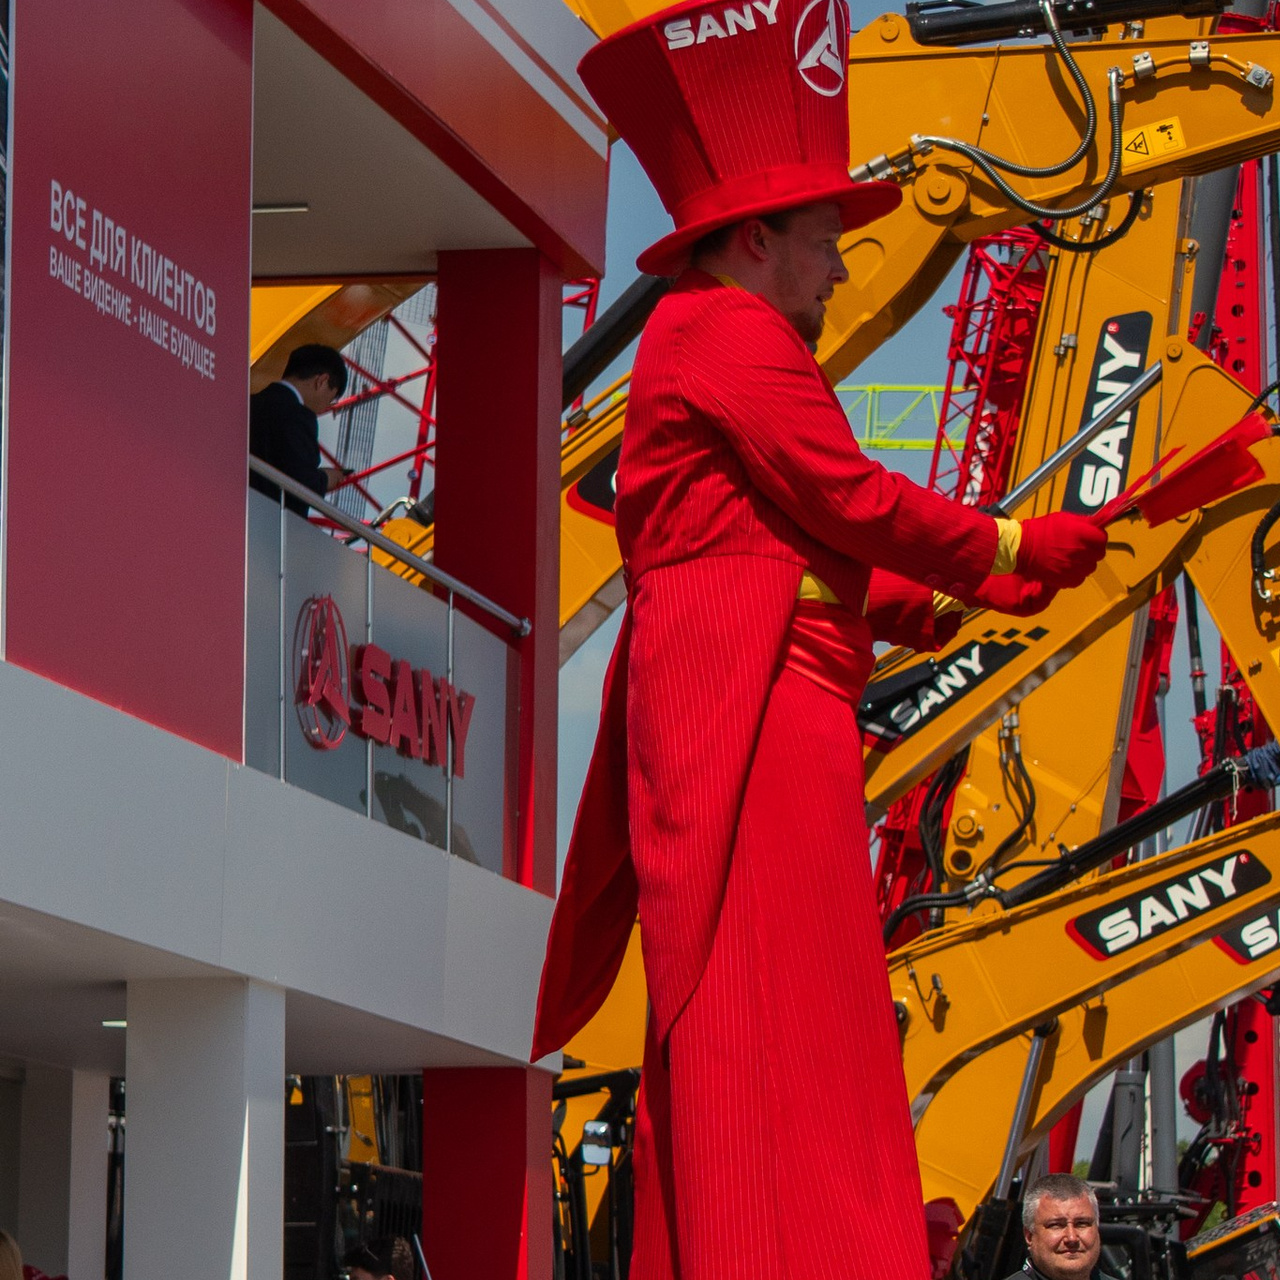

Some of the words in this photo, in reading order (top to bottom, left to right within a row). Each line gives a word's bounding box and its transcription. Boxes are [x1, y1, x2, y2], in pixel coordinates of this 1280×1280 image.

[50, 179, 87, 250] ВСЕ
[90, 208, 126, 277] ДЛЯ
[131, 235, 216, 337] КЛИЕНТОВ
[50, 245, 81, 294] ВАШЕ
[84, 269, 131, 326] ВИДЕНИЕ
[139, 305, 168, 349] НАШЕ
[171, 325, 215, 381] БУДУЩЕЕ
[361, 642, 476, 780] SANY
[890, 644, 984, 732] SANY
[1098, 855, 1238, 954] SANY
